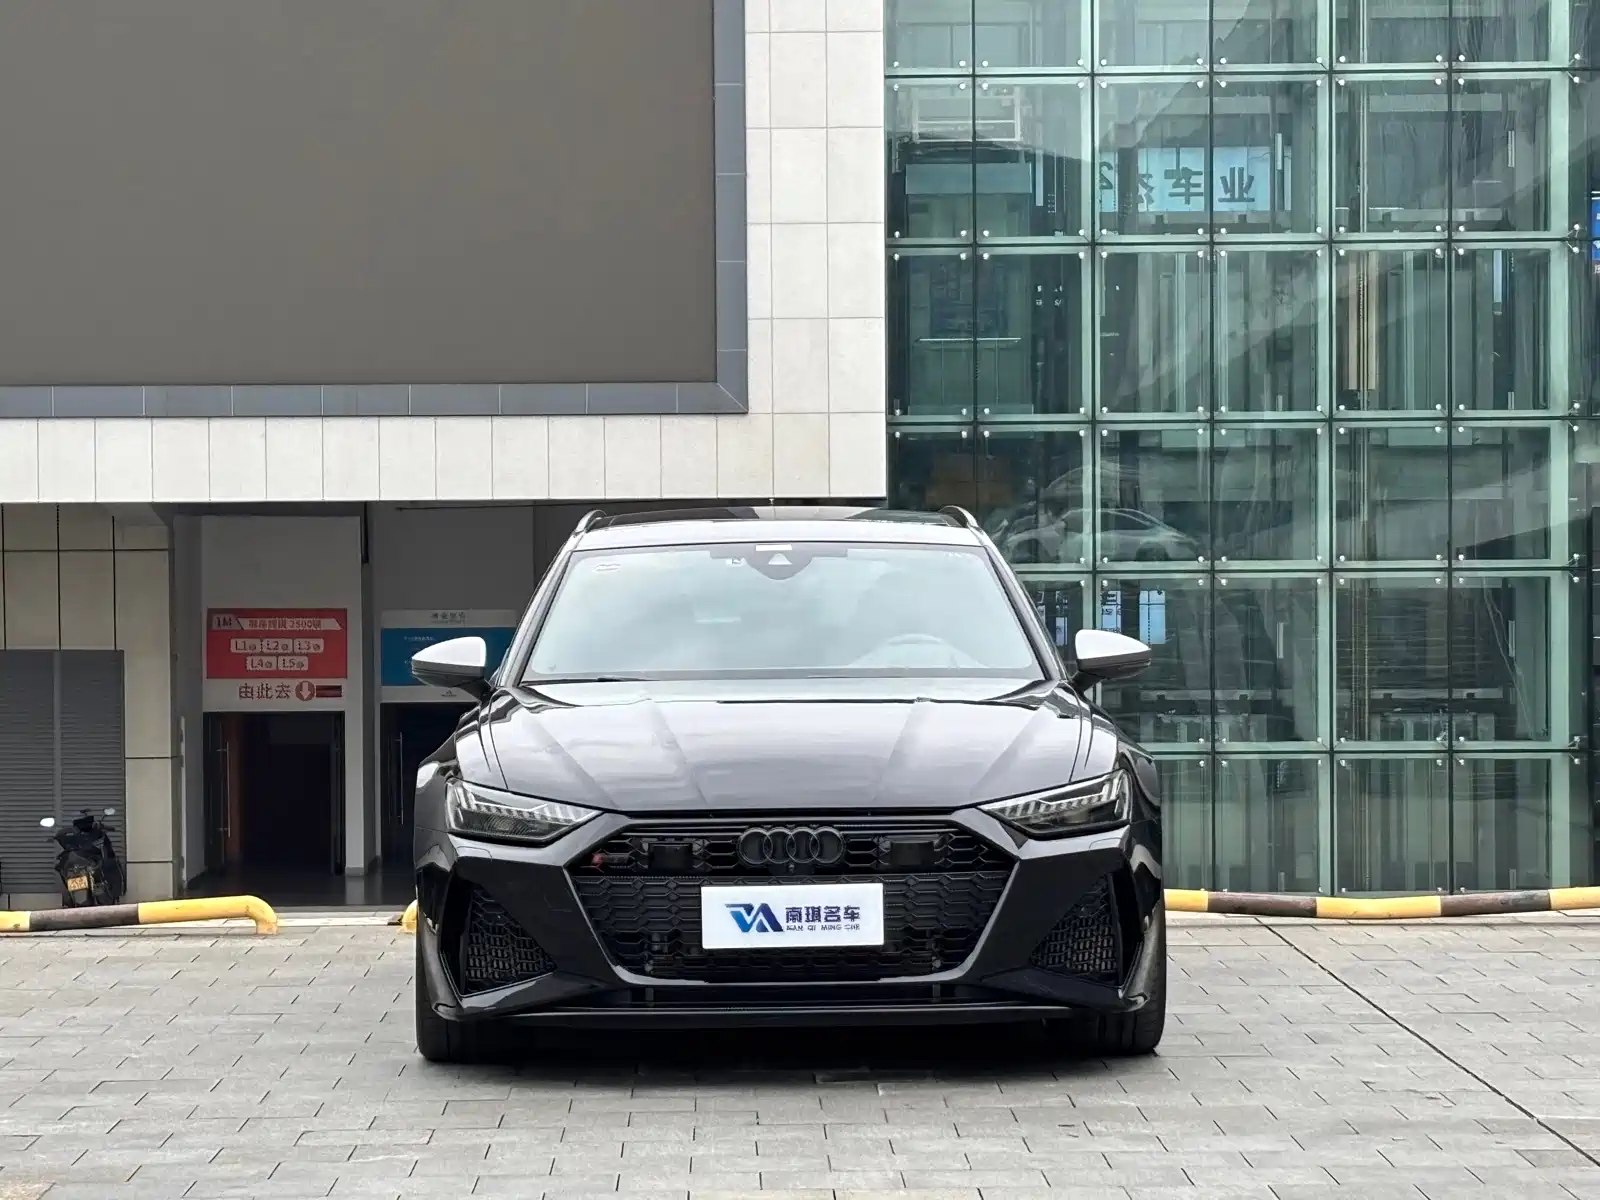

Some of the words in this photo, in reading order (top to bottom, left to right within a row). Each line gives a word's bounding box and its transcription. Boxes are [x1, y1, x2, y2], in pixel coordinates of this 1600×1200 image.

[238, 682, 292, 700] 由此去
[807, 924, 817, 932] QI
[820, 924, 842, 932] MING
